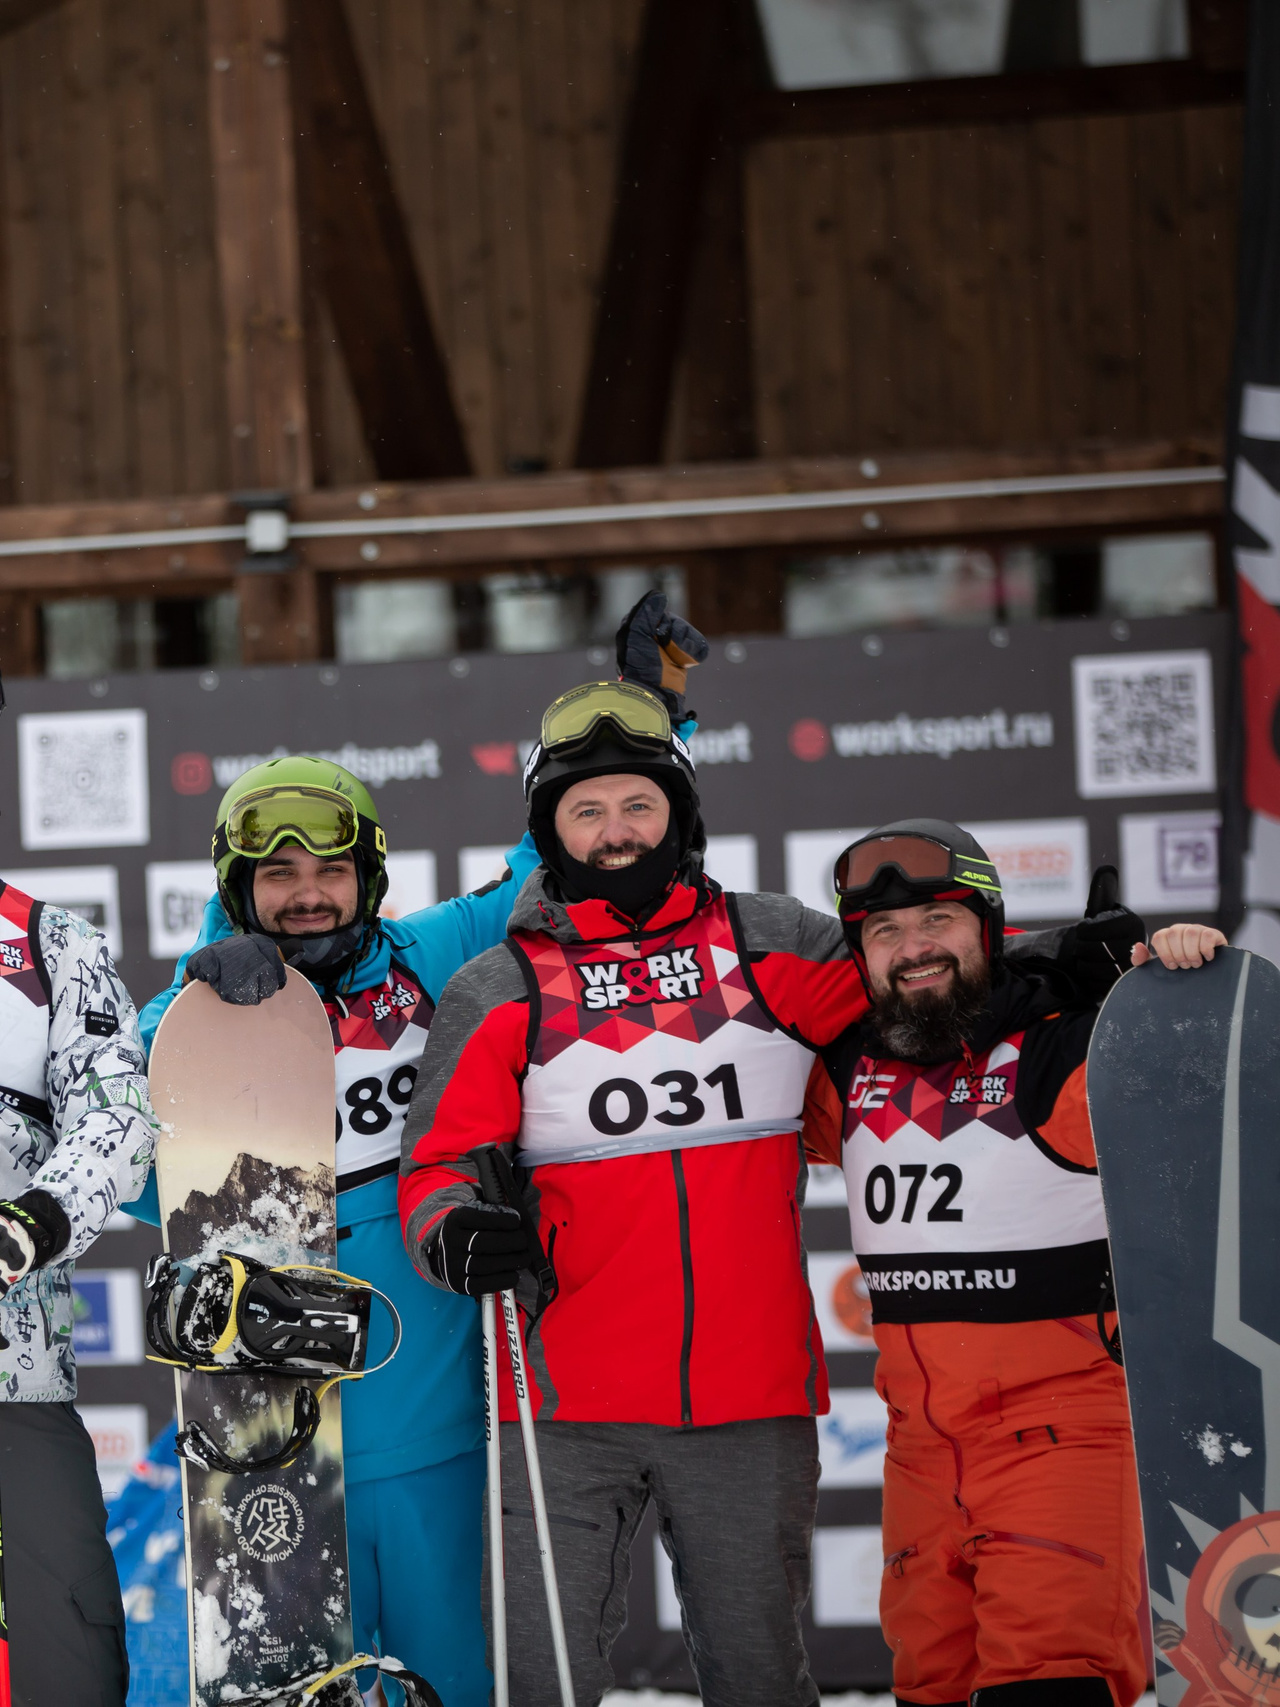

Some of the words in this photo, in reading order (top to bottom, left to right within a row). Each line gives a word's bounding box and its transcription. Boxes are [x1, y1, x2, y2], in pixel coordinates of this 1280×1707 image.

[831, 707, 1054, 760] worksport.ru
[961, 870, 993, 884] ALPINA
[336, 1064, 418, 1144] 89
[588, 1063, 744, 1136] 031
[865, 1163, 963, 1225] 072
[0, 1201, 36, 1225] LEKI
[237, 1489, 257, 1511] YOUR
[255, 1484, 266, 1495] OF
[267, 1484, 285, 1495] SIDE
[237, 1535, 261, 1560] HOOD
[290, 1532, 303, 1549] MY
[260, 1546, 293, 1563] MOUNT
[260, 1654, 289, 1665] JOINT
